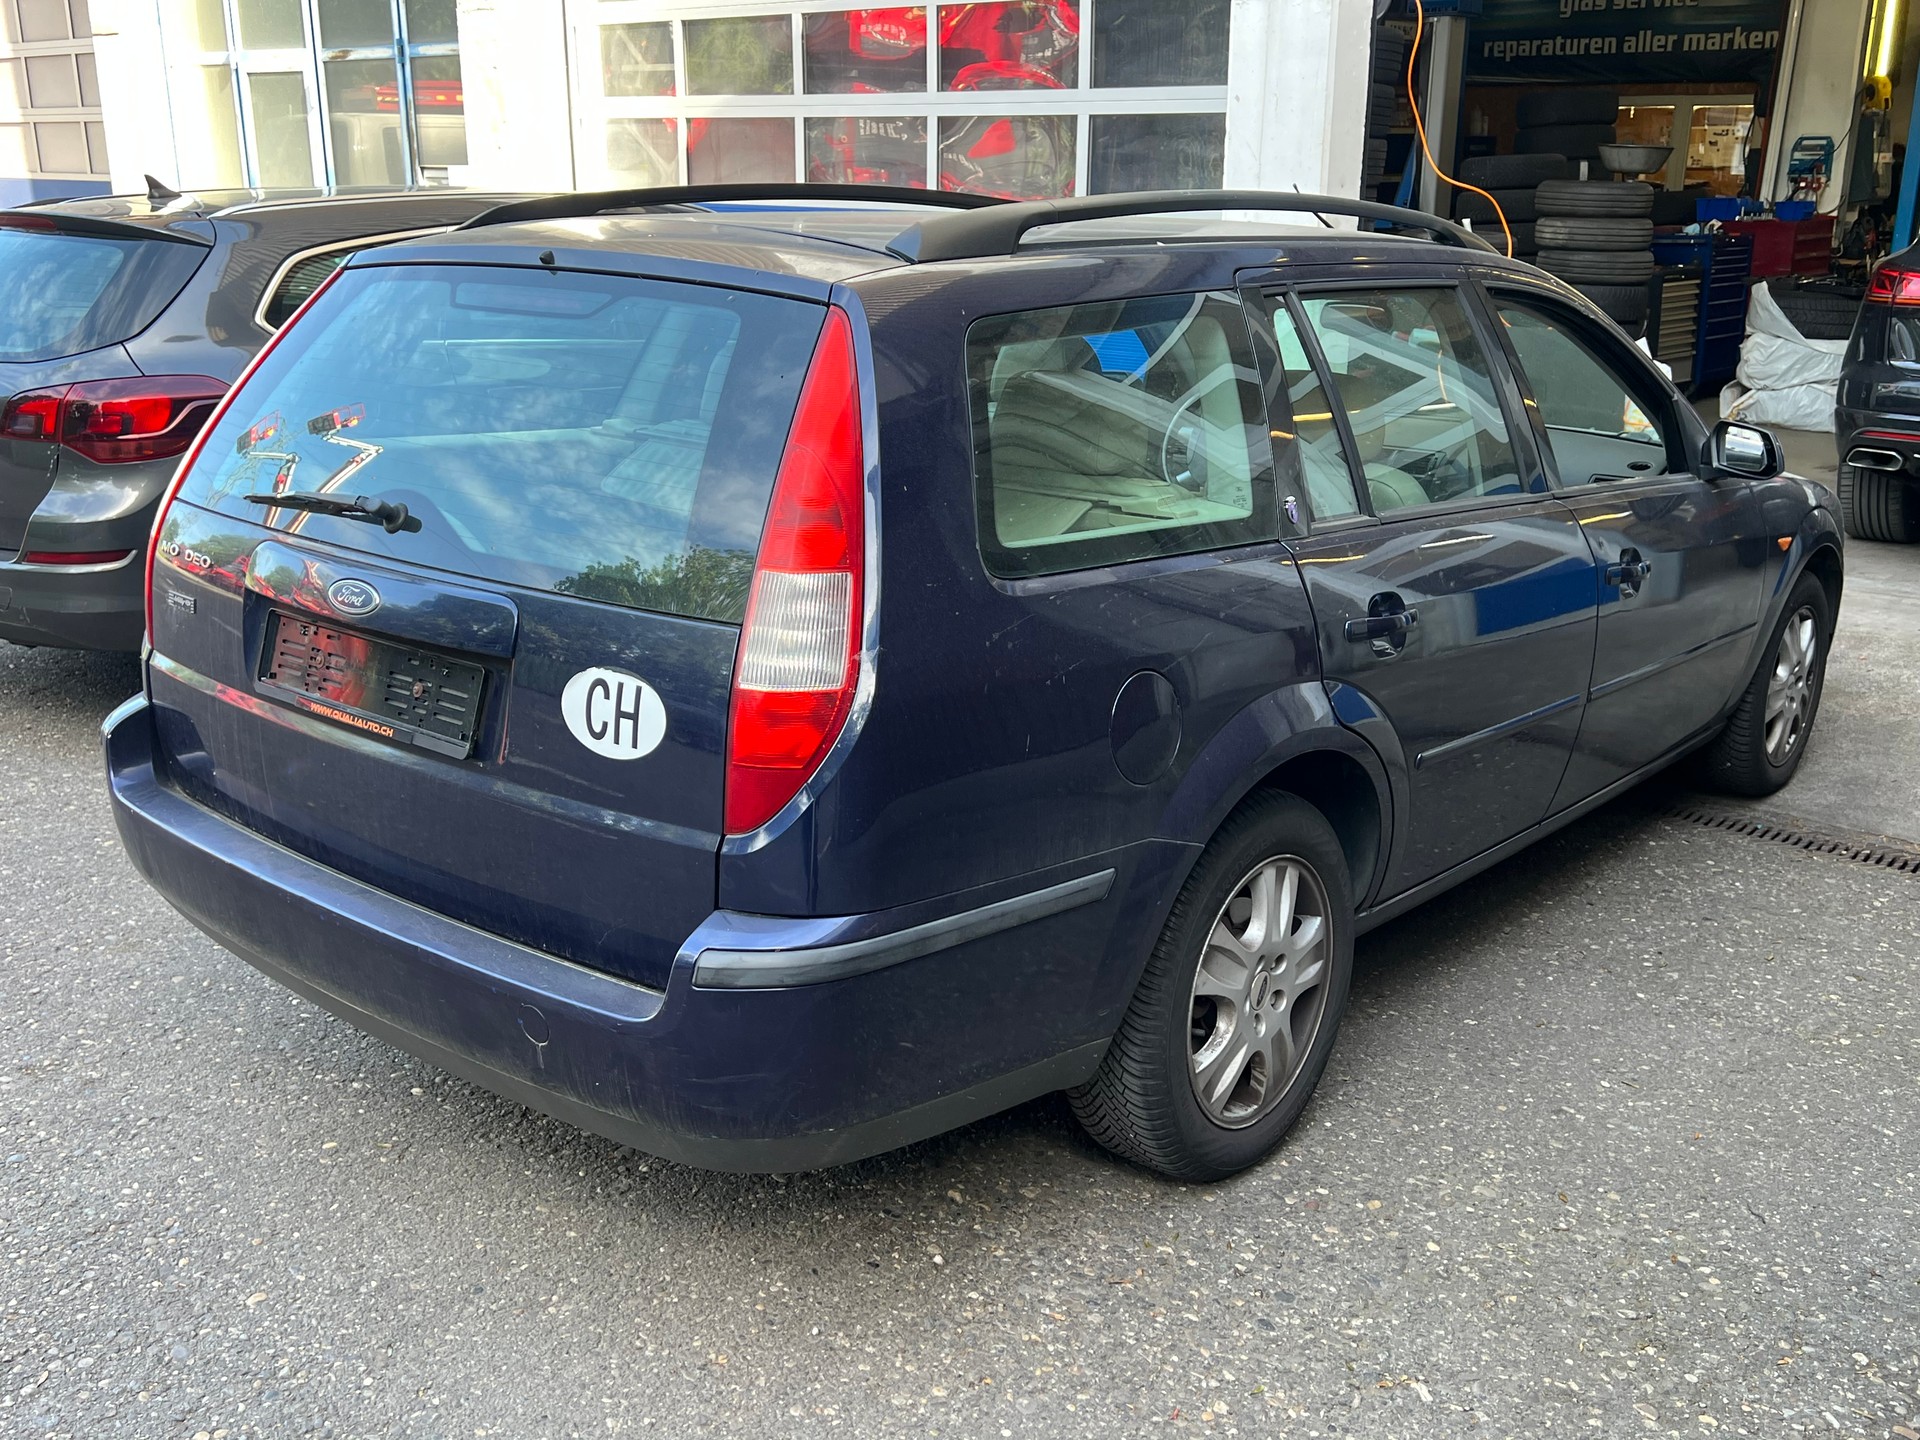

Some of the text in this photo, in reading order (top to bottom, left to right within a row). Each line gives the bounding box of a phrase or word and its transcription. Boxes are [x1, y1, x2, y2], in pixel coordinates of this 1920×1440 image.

[1483, 26, 1779, 62] reparaturen aller marken
[337, 585, 366, 607] Ford
[310, 702, 394, 737] WWW.QUALIAUTO.CH
[585, 677, 643, 750] CH
